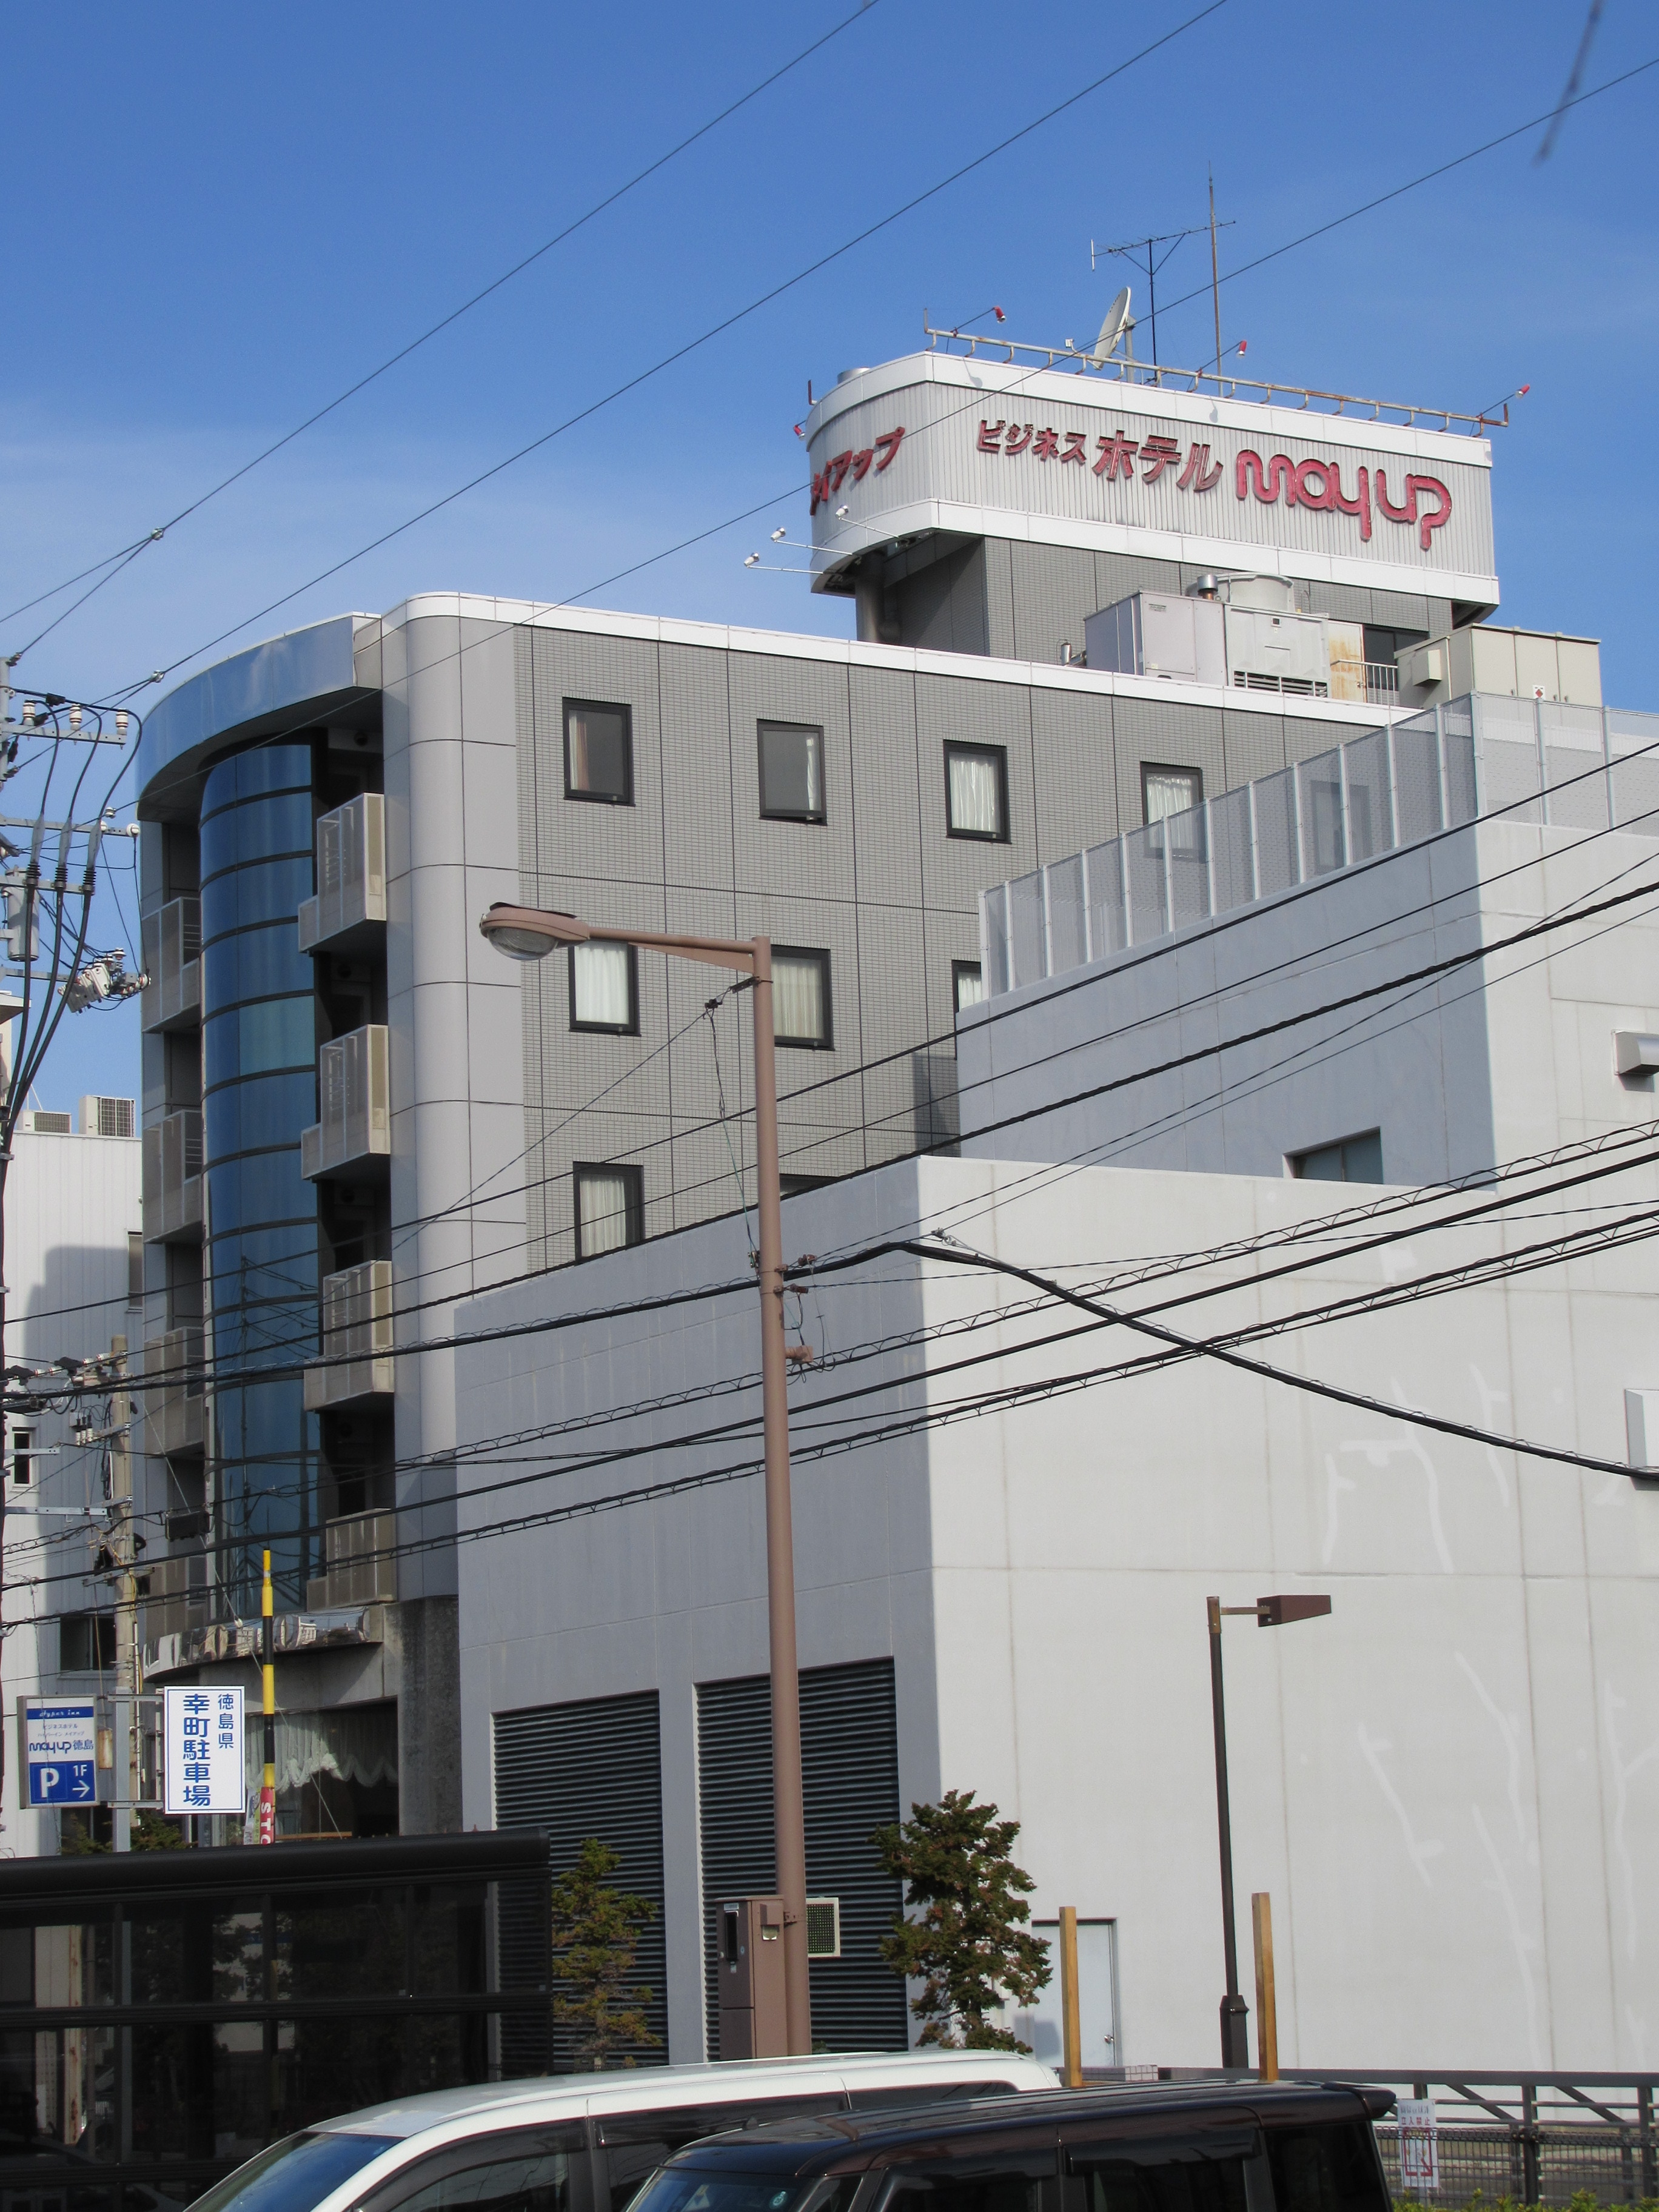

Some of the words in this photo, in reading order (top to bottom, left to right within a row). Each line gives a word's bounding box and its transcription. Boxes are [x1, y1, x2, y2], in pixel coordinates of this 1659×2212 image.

[809, 426, 905, 515] メイアップ
[218, 1694, 233, 1749] 徳島県
[73, 1739, 94, 1750] 徳島
[183, 1694, 211, 1806] 幸町駐車場
[40, 1768, 59, 1798] P
[73, 1765, 87, 1777] 1F
[1401, 2116, 1430, 2125] 立入禁止
